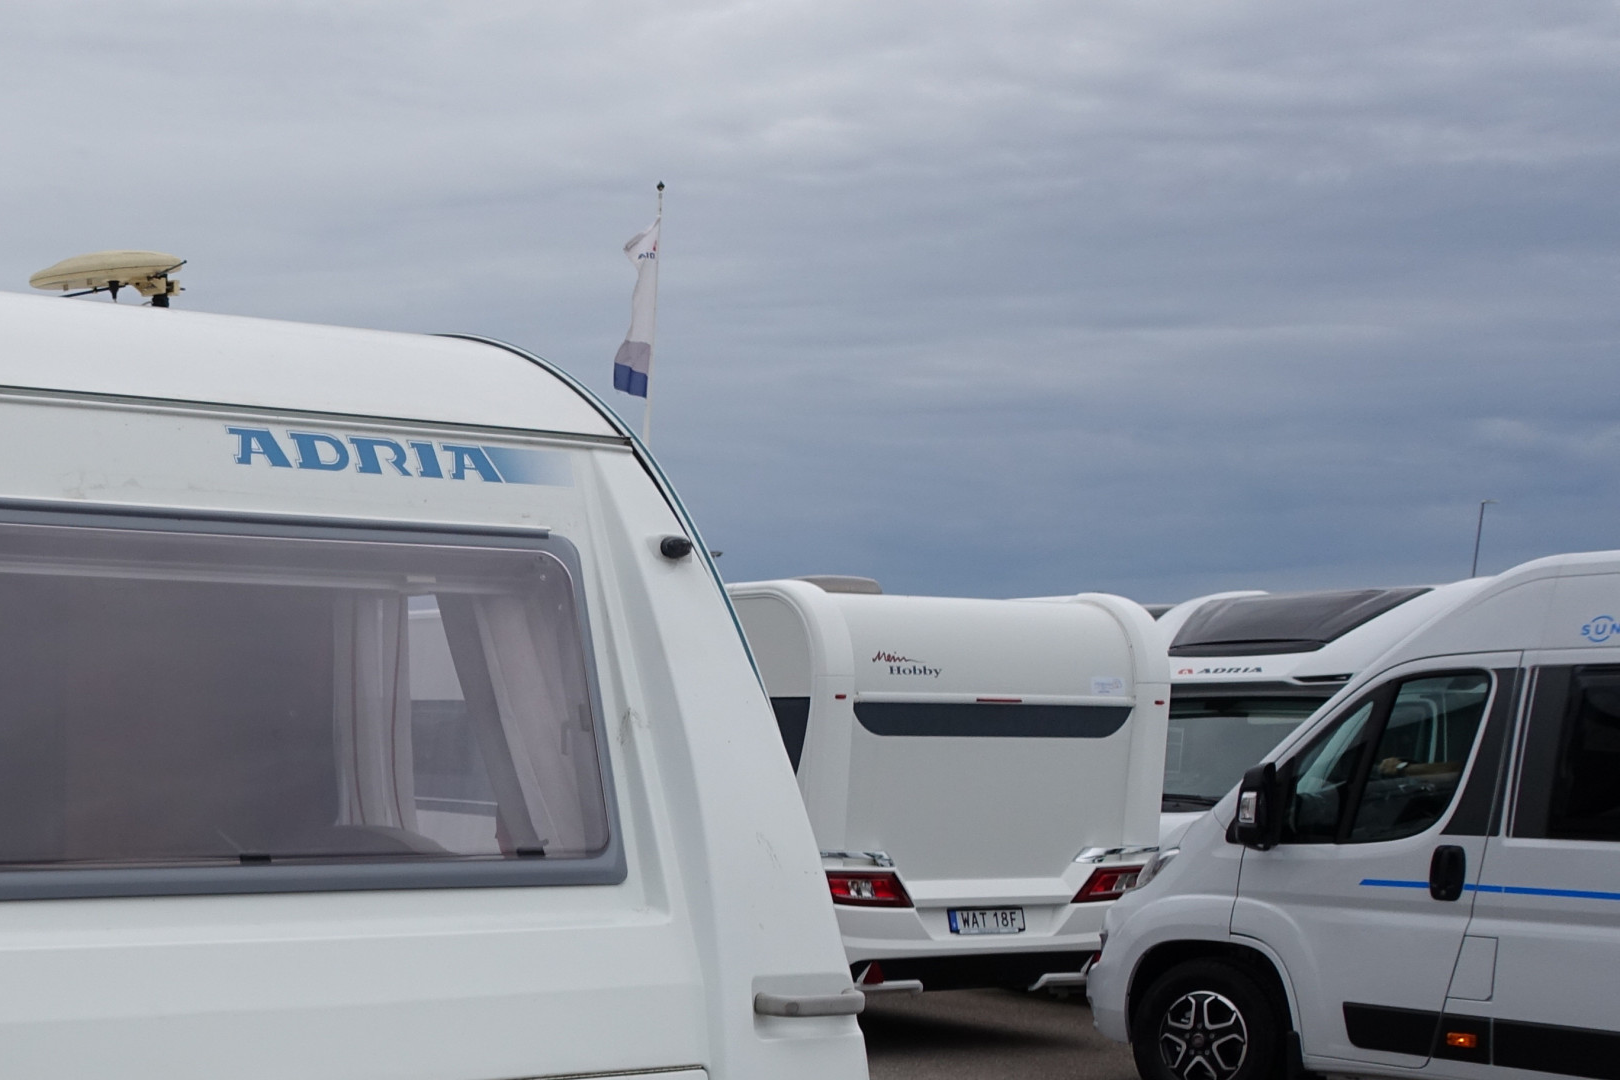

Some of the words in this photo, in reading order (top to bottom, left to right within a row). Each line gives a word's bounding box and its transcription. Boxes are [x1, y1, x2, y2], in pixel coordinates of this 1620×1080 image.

[224, 424, 506, 483] ADRIA
[872, 650, 916, 663] Mein
[889, 665, 942, 678] Hobby
[1196, 666, 1263, 674] ADRIA
[960, 911, 987, 928] WAT
[993, 911, 1017, 928] 18F
